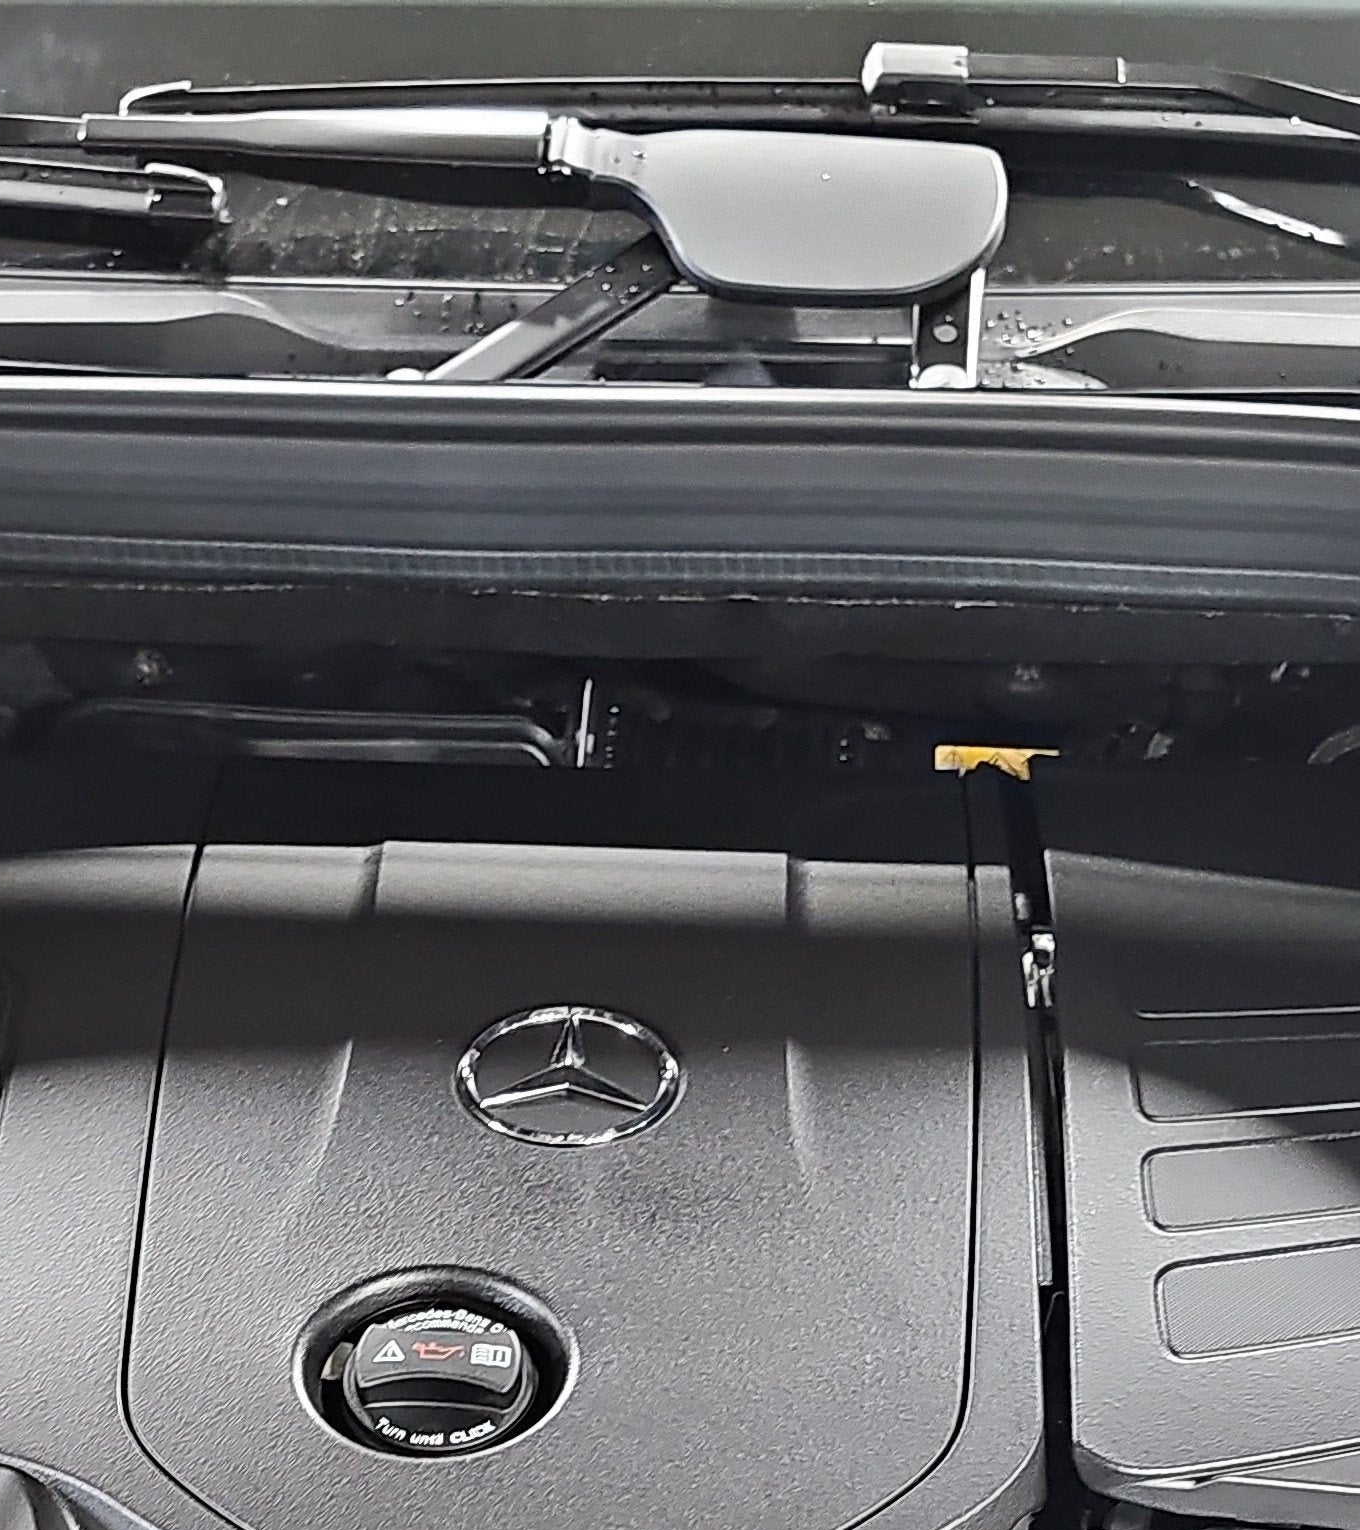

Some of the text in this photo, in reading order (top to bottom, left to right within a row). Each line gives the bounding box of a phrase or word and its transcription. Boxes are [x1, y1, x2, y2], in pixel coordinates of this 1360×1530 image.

[374, 1416, 497, 1446] Turn until CLICK
